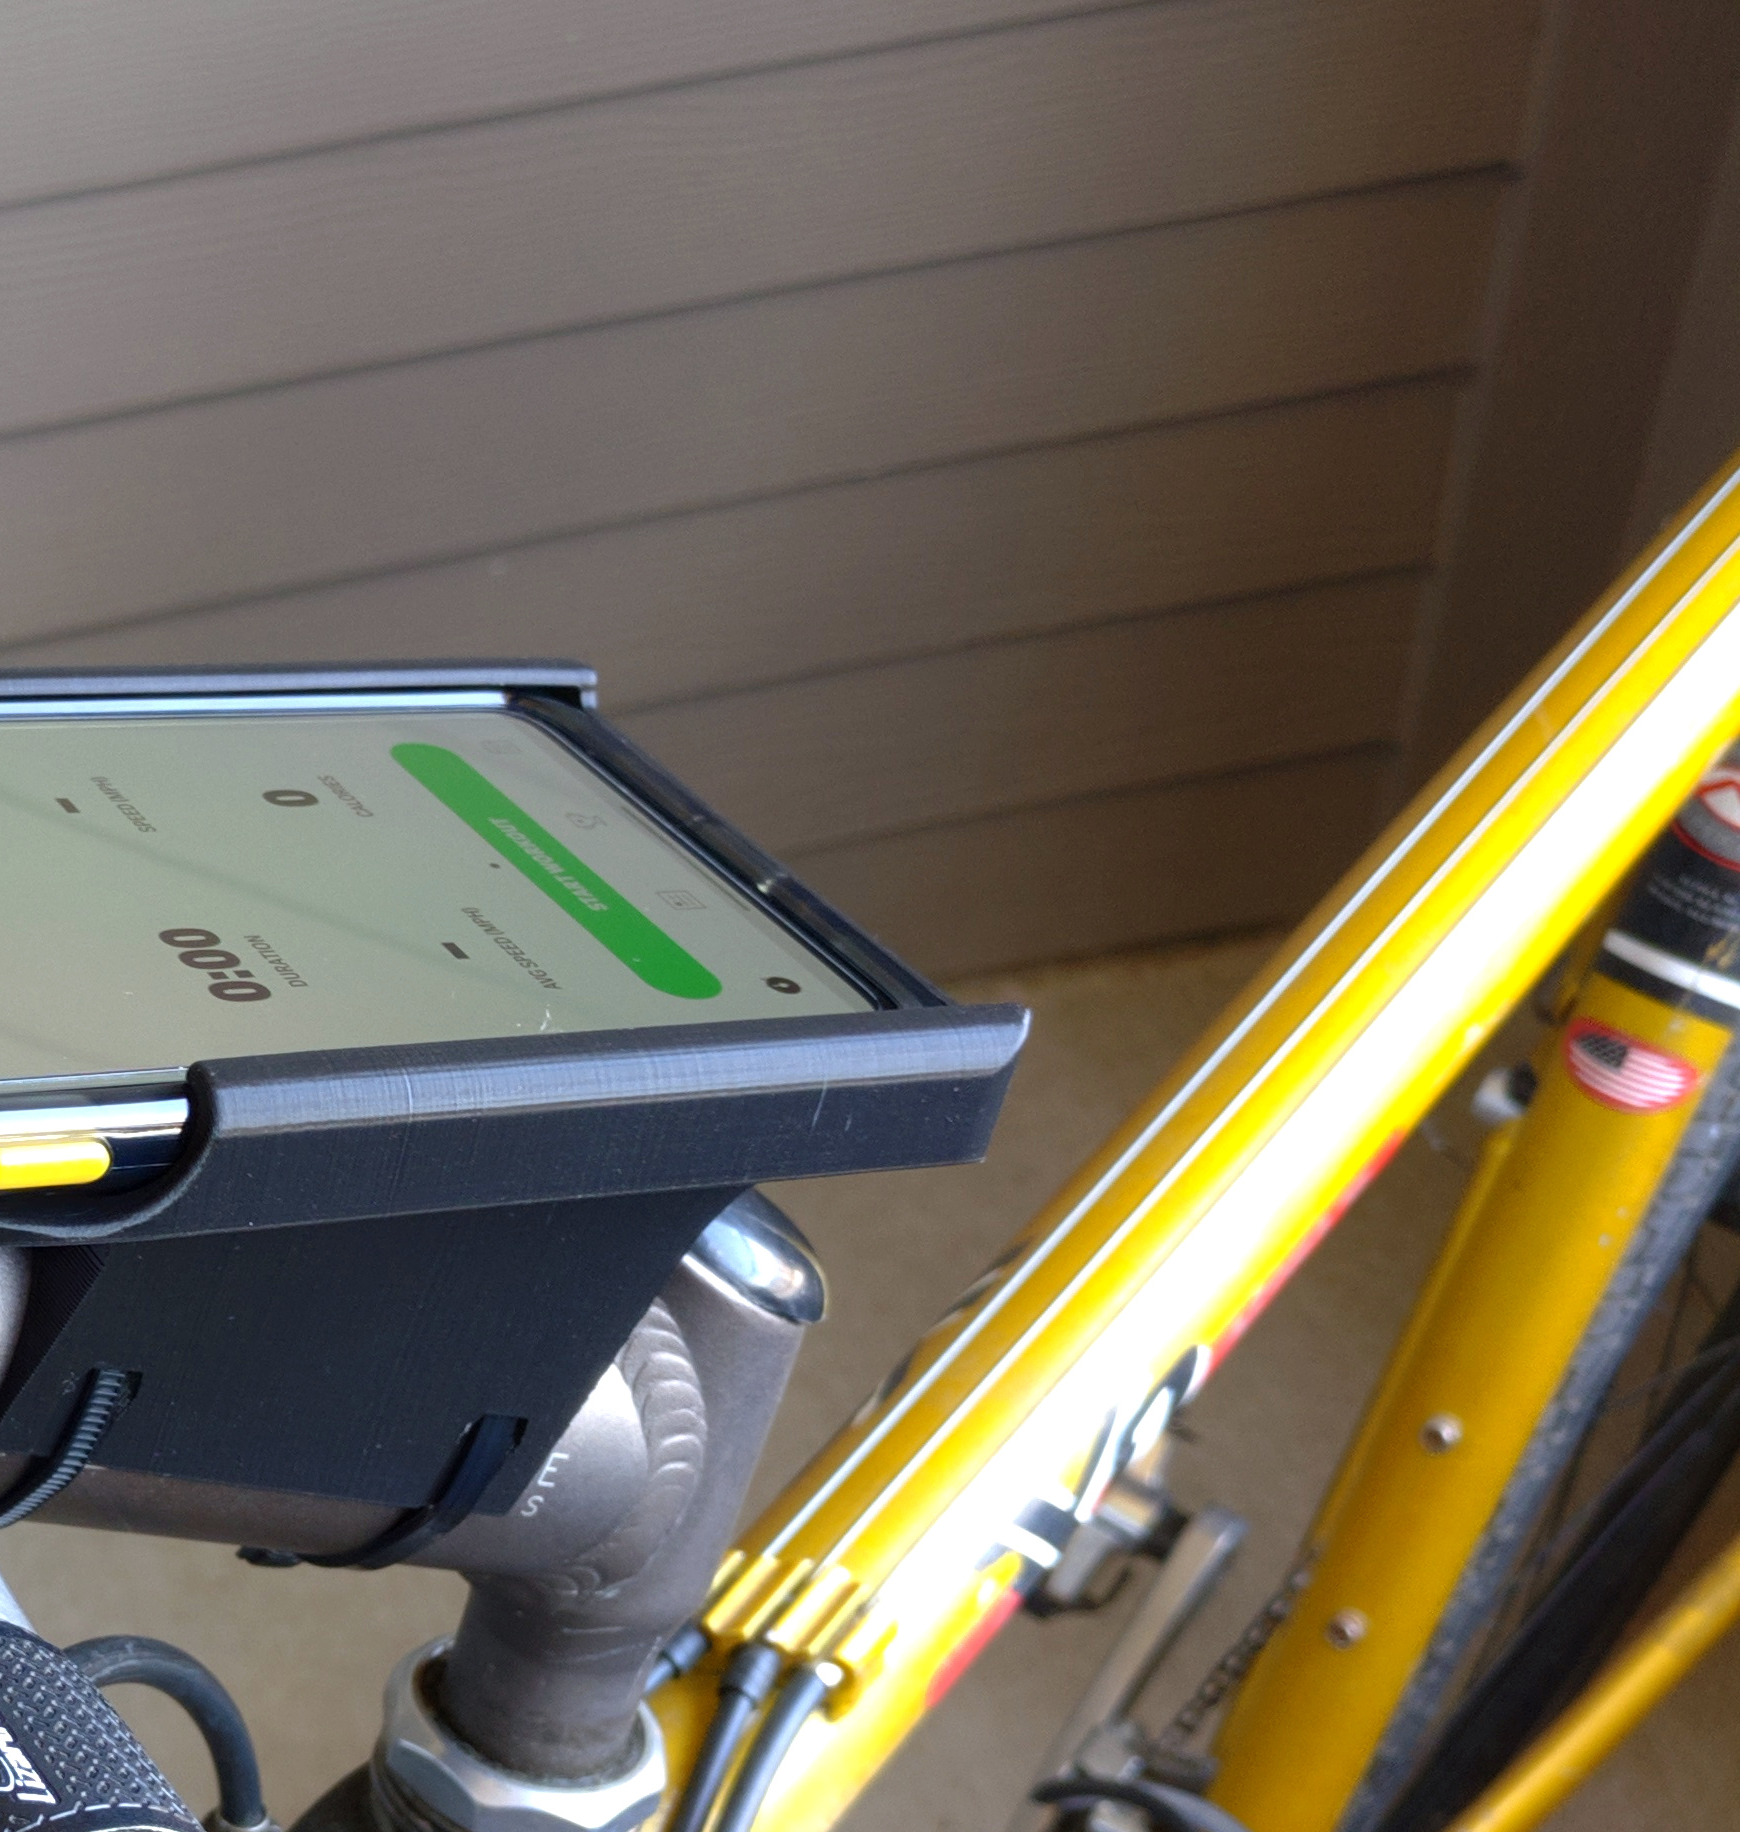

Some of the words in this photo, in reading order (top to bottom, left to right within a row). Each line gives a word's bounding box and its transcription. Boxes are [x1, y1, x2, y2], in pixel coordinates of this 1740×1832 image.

[262, 789, 319, 808] 0
[116, 803, 157, 833] SPEED
[487, 815, 565, 875] WORKOUT
[554, 875, 609, 912] START
[461, 906, 505, 936] (MPH)
[158, 927, 272, 1002] 0:00
[243, 934, 309, 989] DURATION
[493, 936, 538, 969] SPEED
[528, 969, 563, 990] AVG
